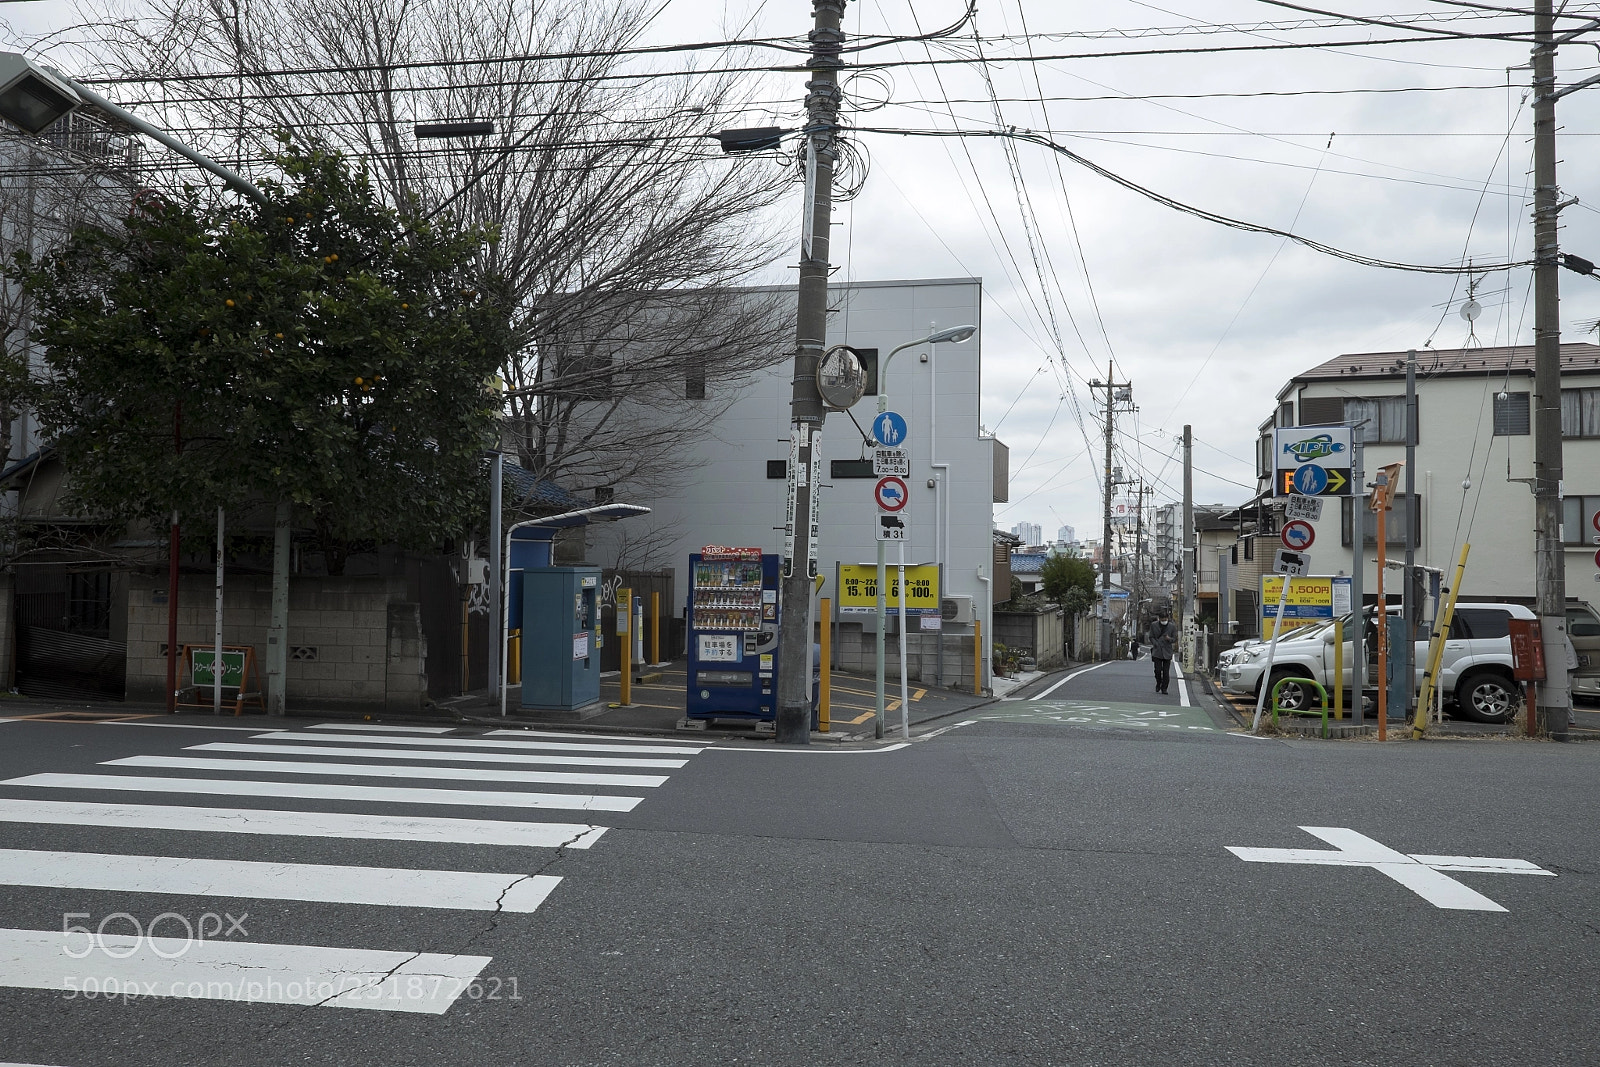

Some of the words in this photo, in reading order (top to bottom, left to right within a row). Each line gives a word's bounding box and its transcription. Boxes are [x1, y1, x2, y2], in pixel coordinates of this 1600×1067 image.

[1283, 441, 1346, 455] KIPTO
[706, 545, 725, 554] ホット
[704, 641, 733, 649] 駐車場を
[704, 648, 733, 656] 予約する
[194, 662, 212, 672] スクール
